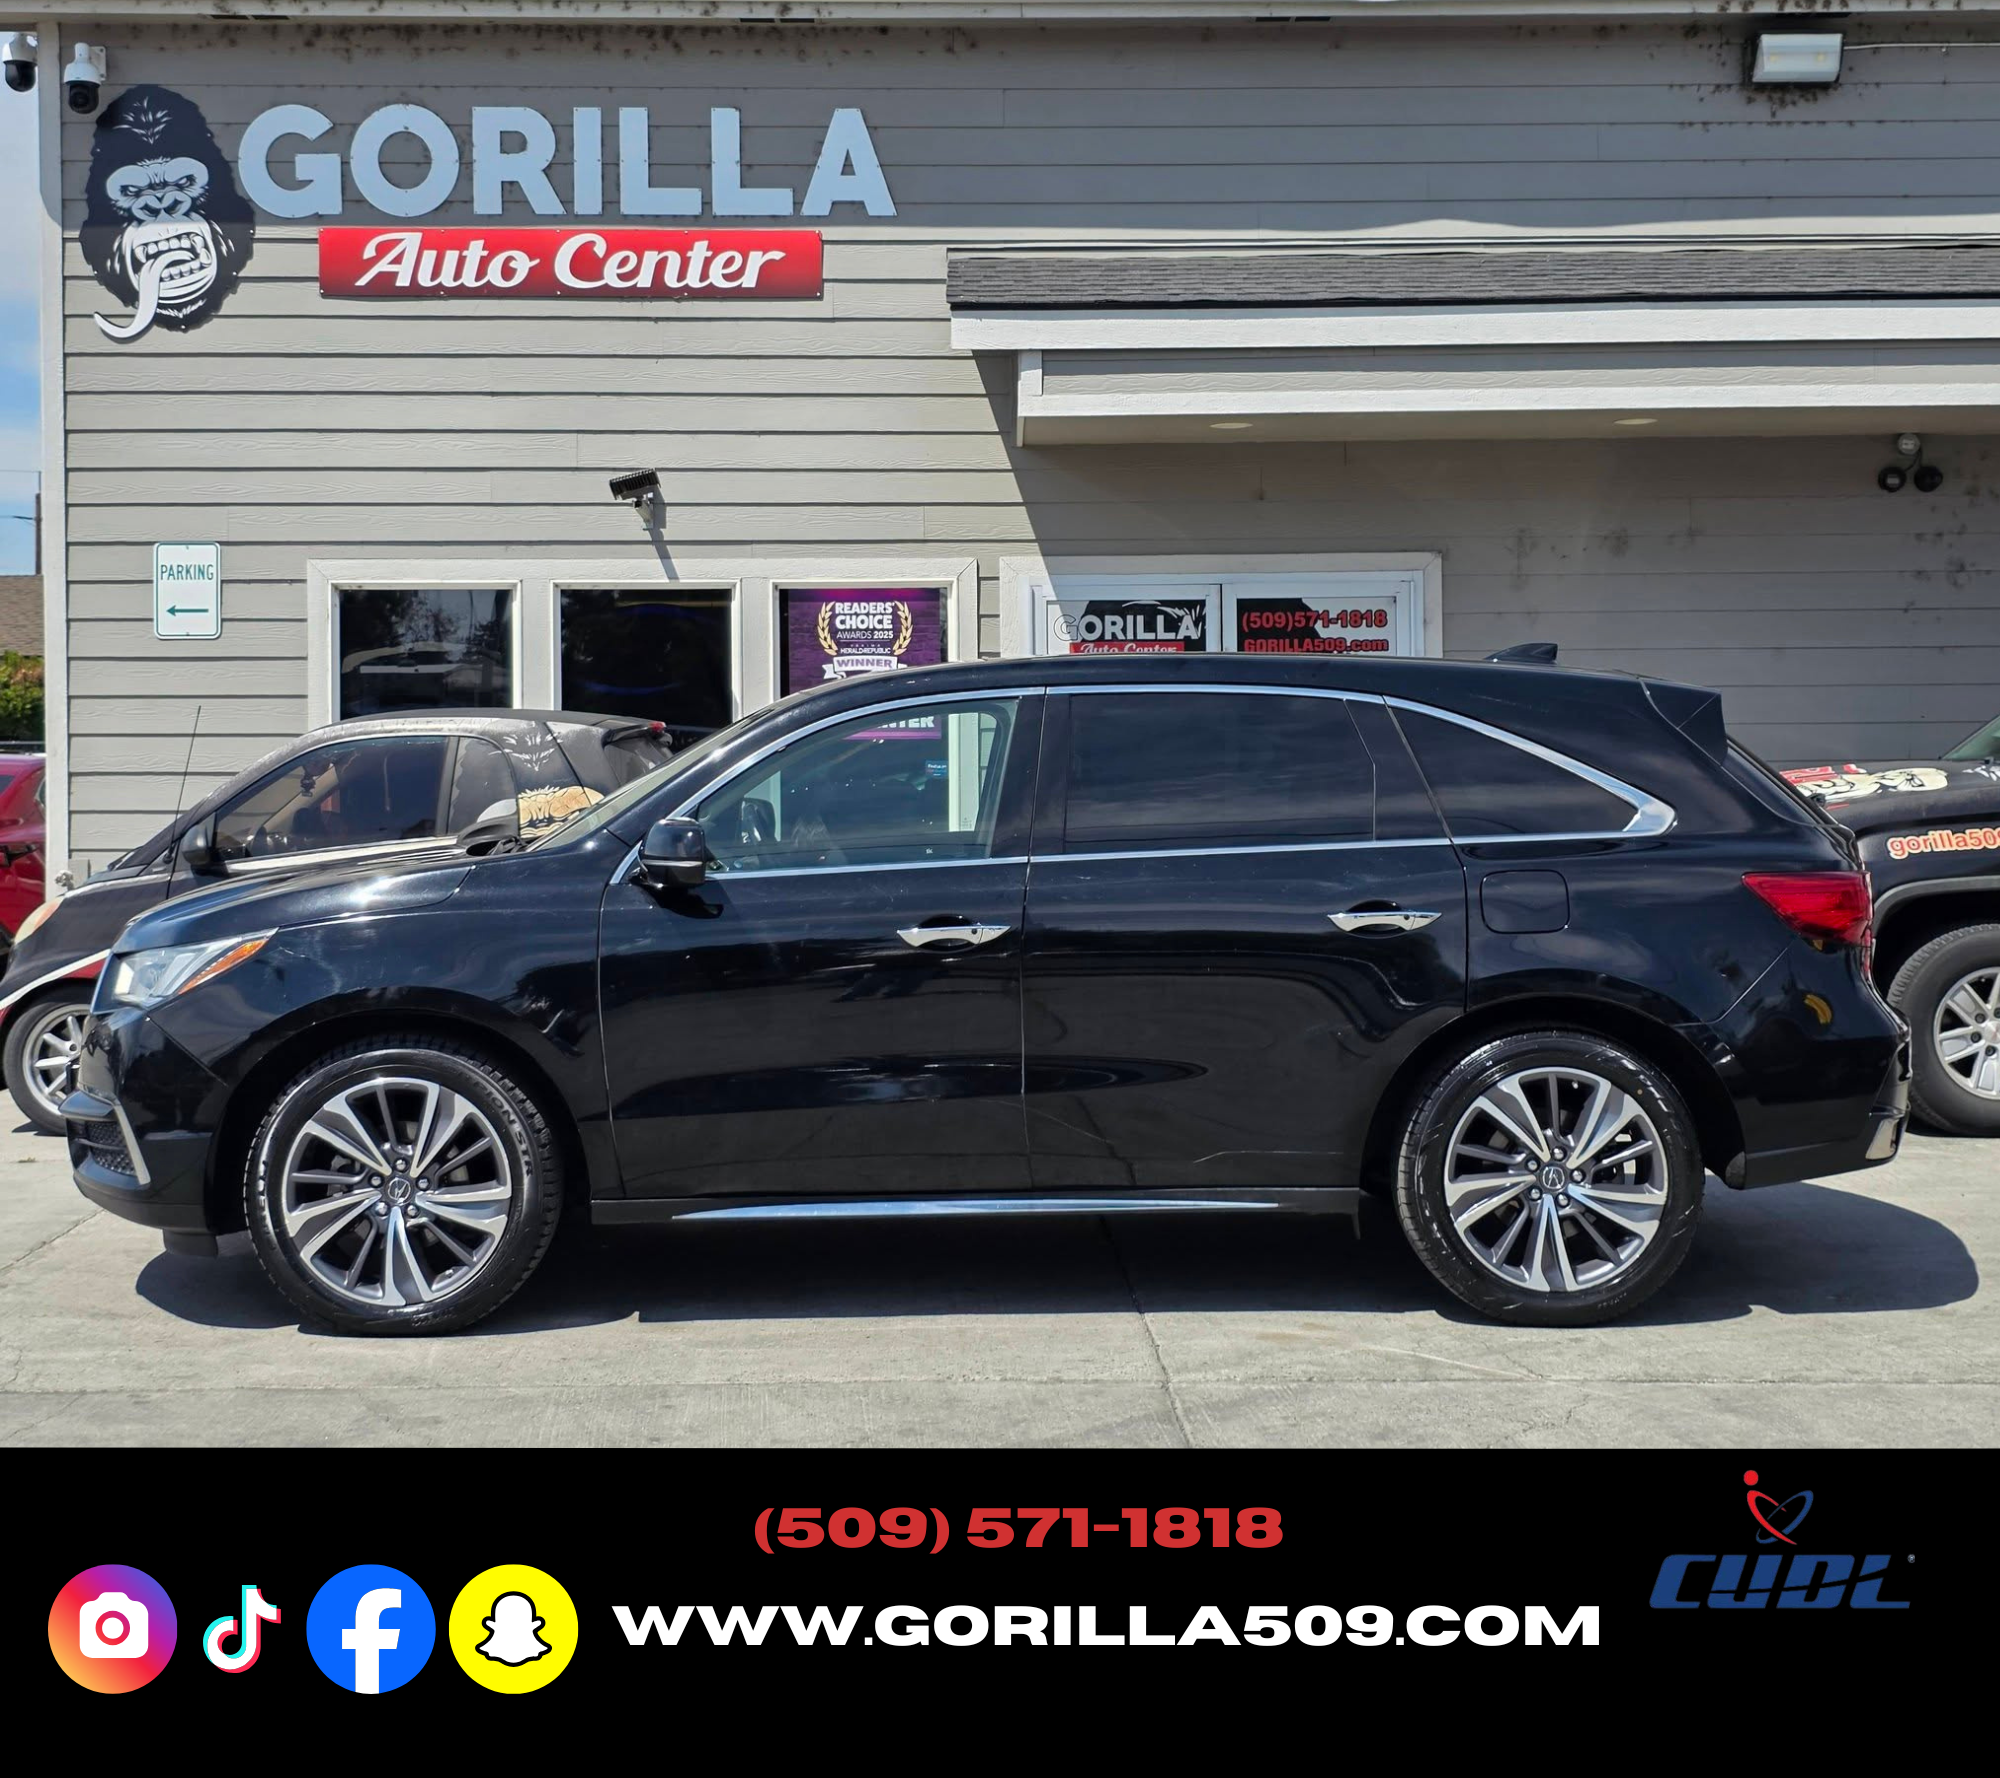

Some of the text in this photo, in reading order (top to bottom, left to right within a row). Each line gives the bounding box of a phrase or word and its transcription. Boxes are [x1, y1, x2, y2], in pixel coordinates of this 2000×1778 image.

[238, 104, 897, 217] GORILLA
[354, 231, 787, 290] Auto Center
[160, 564, 214, 581] PARKING
[835, 602, 895, 614] READERS'
[835, 615, 893, 629] CHOICE
[1053, 614, 1198, 641] GORILLA
[1242, 609, 1388, 632] (509)571-1818
[836, 630, 894, 639] AWARDS 2025
[1244, 637, 1389, 653] GORILLA509.com
[836, 658, 893, 669] WINNER
[1888, 828, 2000, 858] gorilla50
